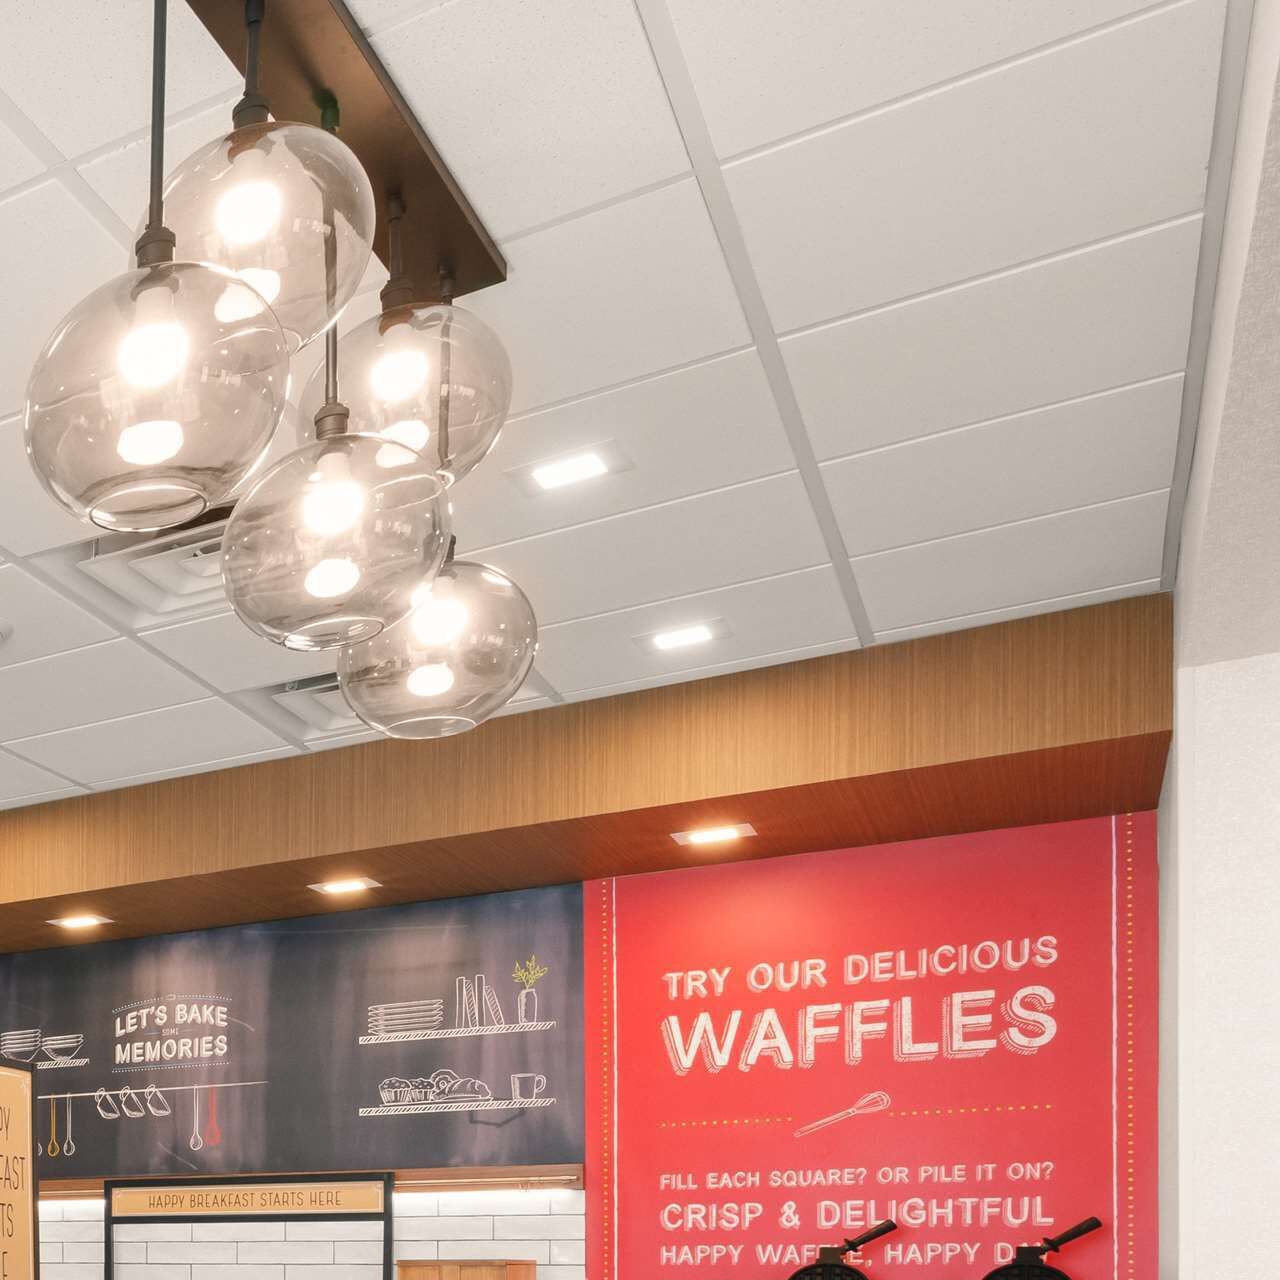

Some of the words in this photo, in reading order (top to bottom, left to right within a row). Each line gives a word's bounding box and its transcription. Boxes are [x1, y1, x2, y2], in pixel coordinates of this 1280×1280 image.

[662, 966, 732, 1000] TRY
[747, 958, 828, 992] OUR
[843, 935, 1058, 984] DELICIOUS
[115, 1005, 167, 1038] LET'S
[175, 1004, 229, 1027] BAKE
[162, 1027, 179, 1036] SOME
[660, 985, 1058, 1076] WAFFLES
[115, 1035, 228, 1064] MEMORIES
[659, 1173, 698, 1190] FILL
[706, 1171, 760, 1189] EACH
[769, 1167, 867, 1187] SQUARE?
[876, 1166, 909, 1184] OR
[918, 1164, 967, 1183] PILE
[976, 1163, 997, 1182] IT
[1006, 1161, 1055, 1182] ON?
[148, 1194, 185, 1209] HAPPY
[190, 1192, 254, 1209] BREAKFAST
[259, 1191, 304, 1207] STARTS
[309, 1190, 342, 1206] HERE
[660, 1202, 764, 1231] CRISP
[778, 1201, 801, 1230] &
[817, 1196, 1055, 1229] DELIGHTFUL
[660, 1244, 744, 1266] HAPPY
[884, 1242, 981, 1265] HAPPY
